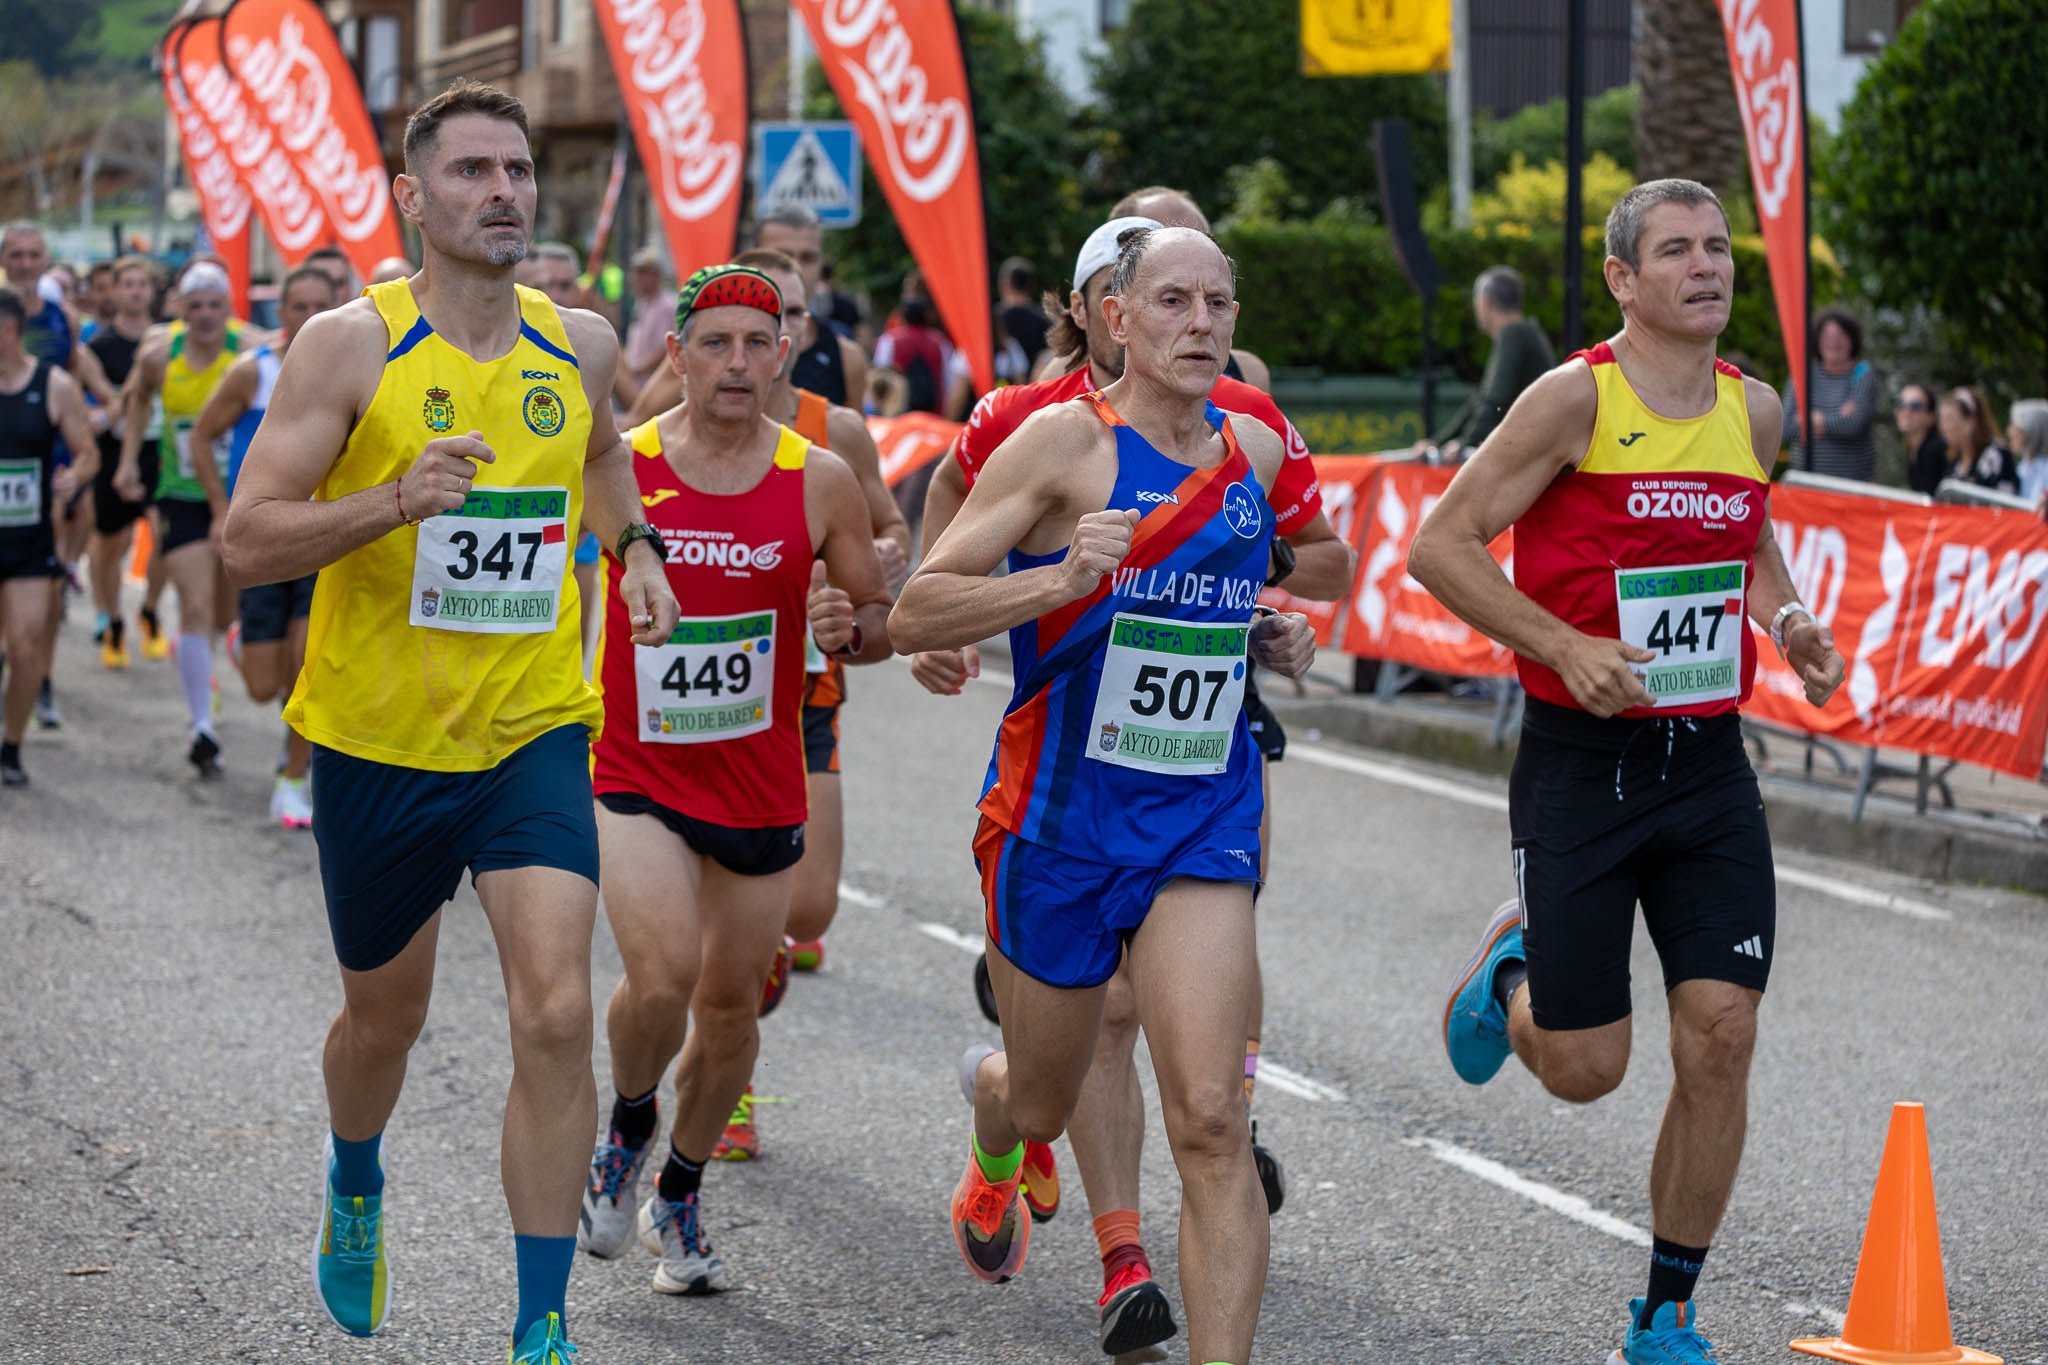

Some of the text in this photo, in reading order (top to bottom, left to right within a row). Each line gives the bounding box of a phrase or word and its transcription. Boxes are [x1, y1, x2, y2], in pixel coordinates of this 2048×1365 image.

[1631, 480, 1708, 492] CLUB DEPORTIVO
[504, 497, 522, 516] DE
[531, 496, 558, 516] AJO
[1627, 492, 1725, 519] OZONO
[657, 528, 735, 541] UB DEPORTIVO
[446, 530, 542, 580] 347
[665, 541, 751, 567] ZONO
[1111, 567, 1177, 604] VILLA
[1180, 572, 1216, 608] DE
[1626, 570, 1736, 599] COSTA DE AJO
[440, 596, 551, 618] AYTO DE BAREYO
[706, 625, 728, 644] DE
[737, 620, 767, 638] AJO
[1121, 624, 1243, 654] COSTA DE AJO
[1646, 604, 1726, 657] 447
[662, 653, 751, 698] 449
[1648, 671, 1678, 694] AYTO
[1680, 670, 1695, 690] DE
[1696, 665, 1732, 689] BAREYO
[1129, 664, 1229, 721] 507
[697, 711, 714, 730] DE
[1119, 731, 1225, 760] AYTO DE BAREYO
